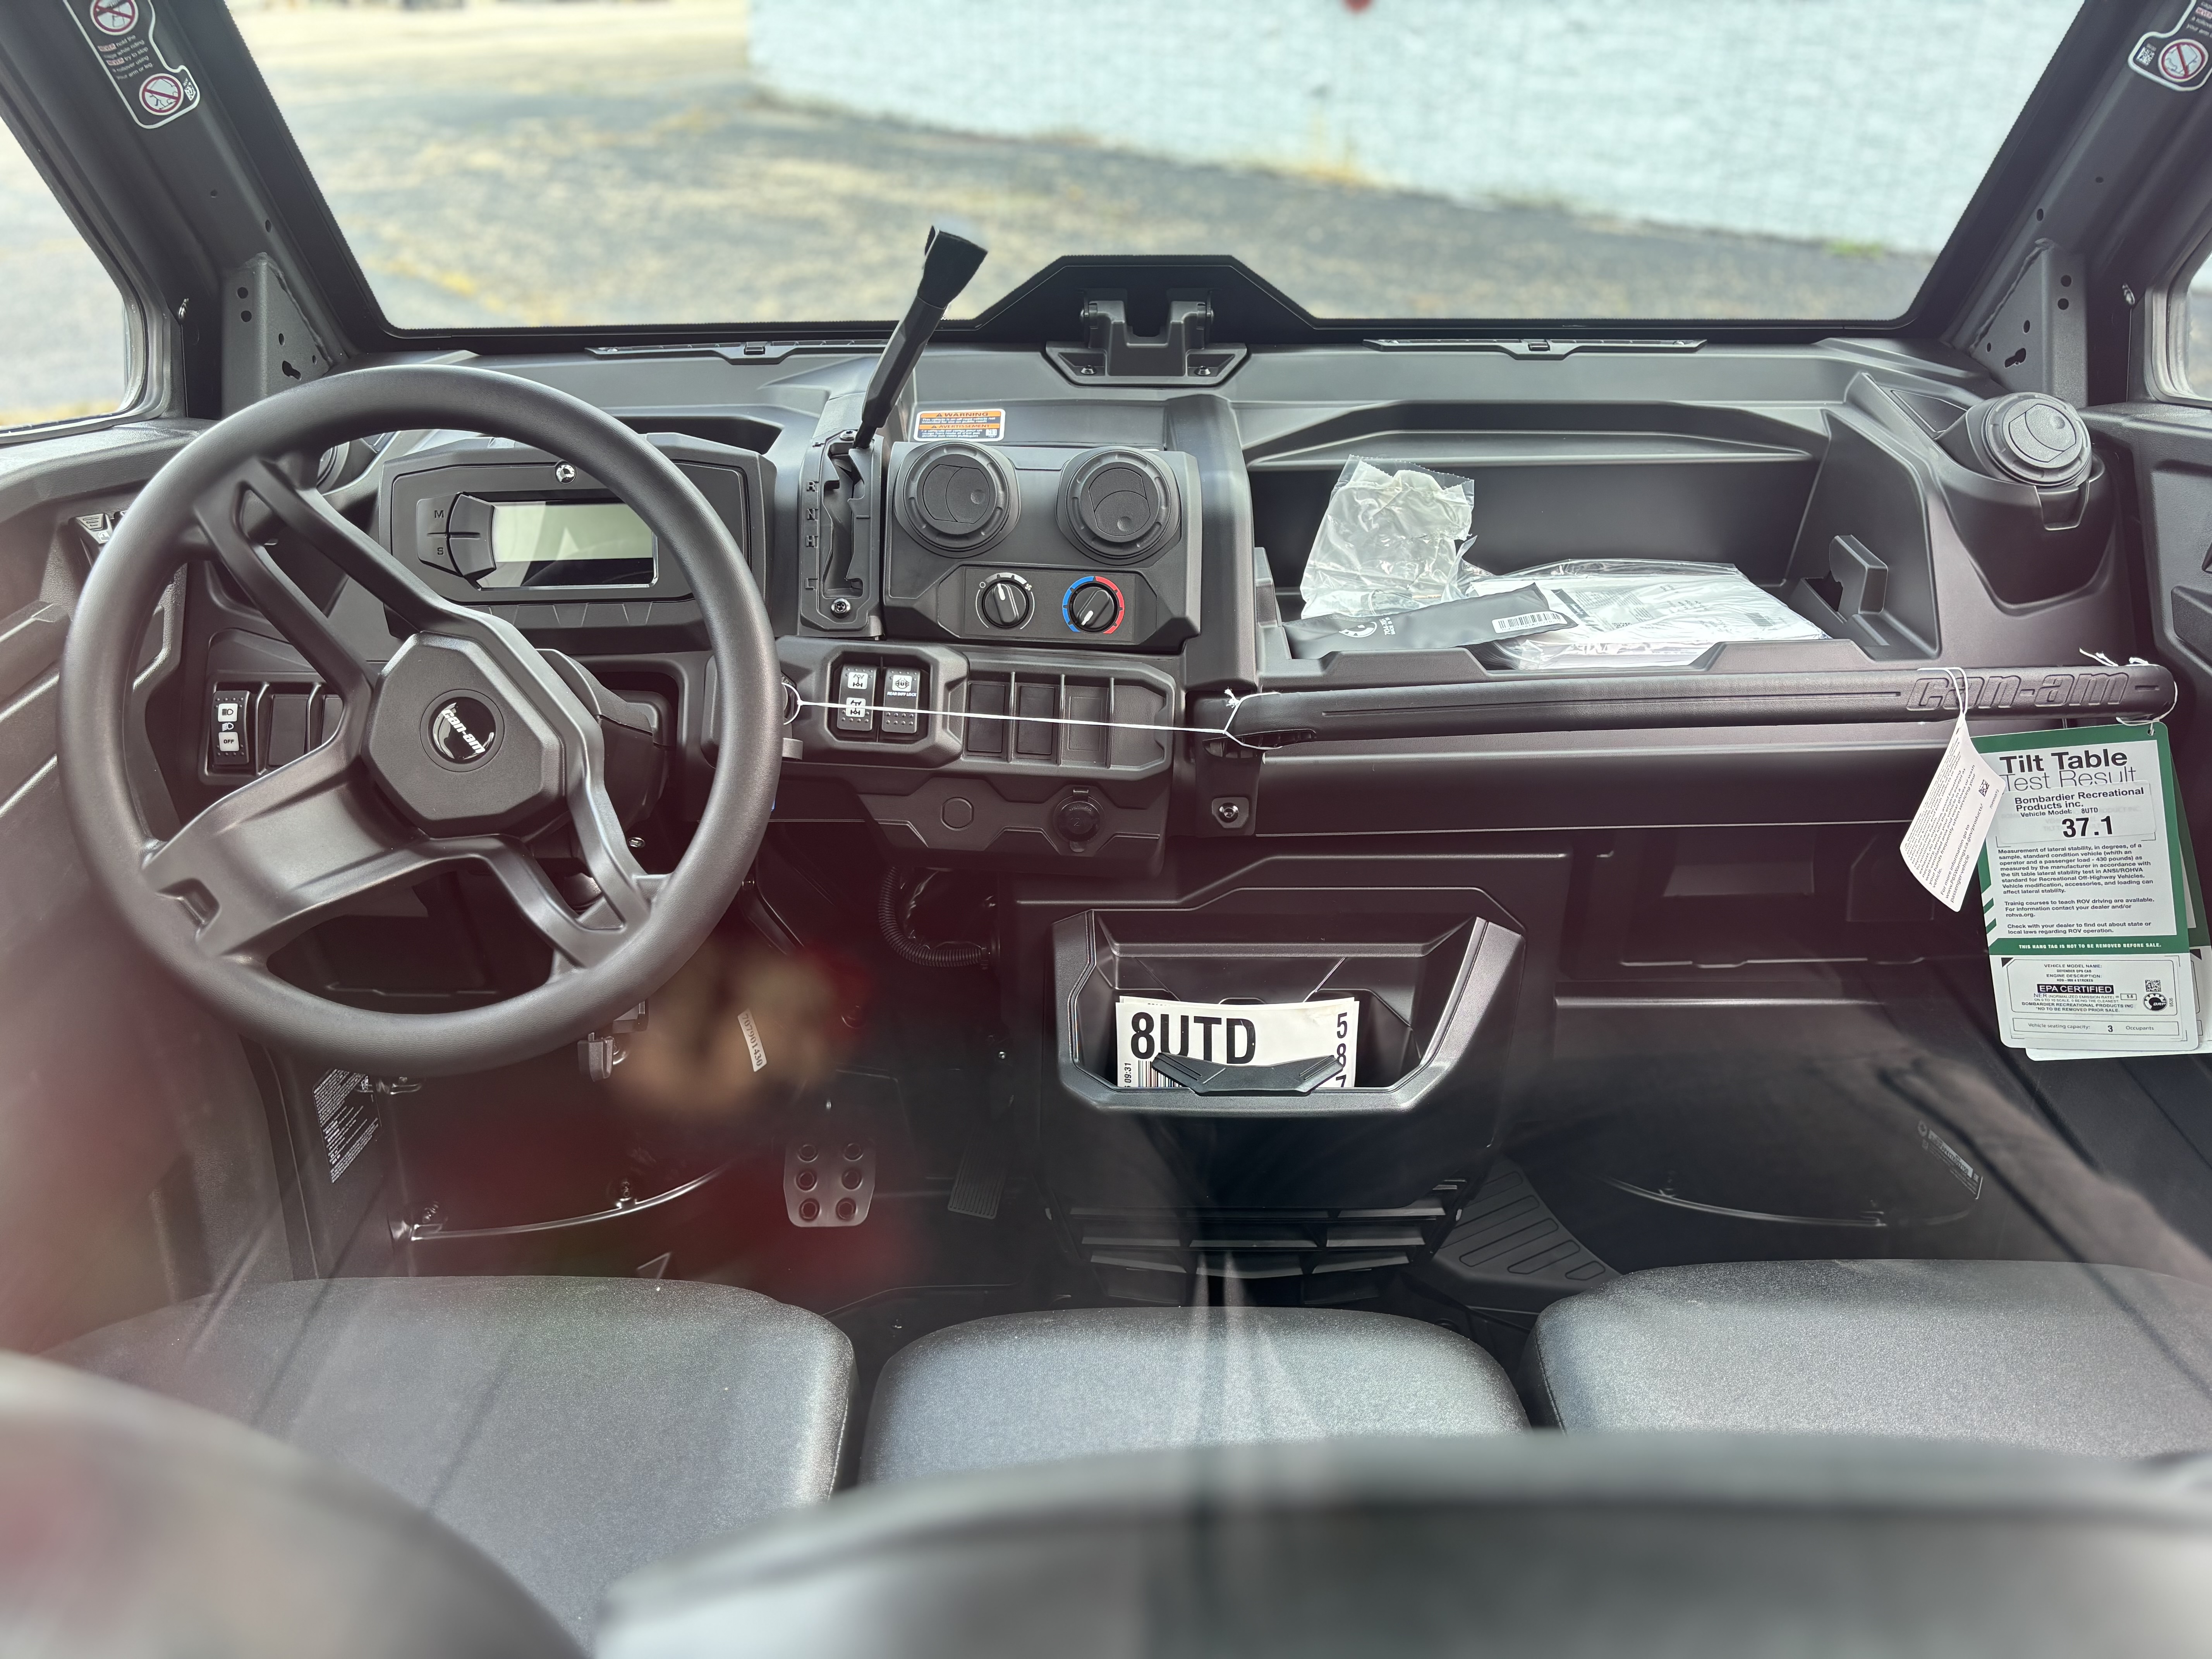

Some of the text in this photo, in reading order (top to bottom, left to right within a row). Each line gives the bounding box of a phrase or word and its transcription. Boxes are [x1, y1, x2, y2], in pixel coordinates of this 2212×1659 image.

[807, 481, 815, 491] R
[434, 510, 444, 518] M
[807, 509, 815, 520] N
[806, 536, 815, 547] H
[441, 709, 486, 754] can-am
[1999, 749, 2127, 773] Tilt Table
[1999, 766, 2136, 791] Test Result
[2014, 787, 2144, 804] Bombardier Recreational
[2016, 802, 2062, 812] Products
[2062, 816, 2112, 838] 37.1
[1941, 826, 1953, 854] frequently
[1950, 840, 1964, 871] information
[1933, 869, 1942, 887] vehicle.
[1951, 855, 1969, 903] passenger-vehicle
[742, 1013, 763, 1066] 707901430
[1131, 1012, 1255, 1064] 8UTD
